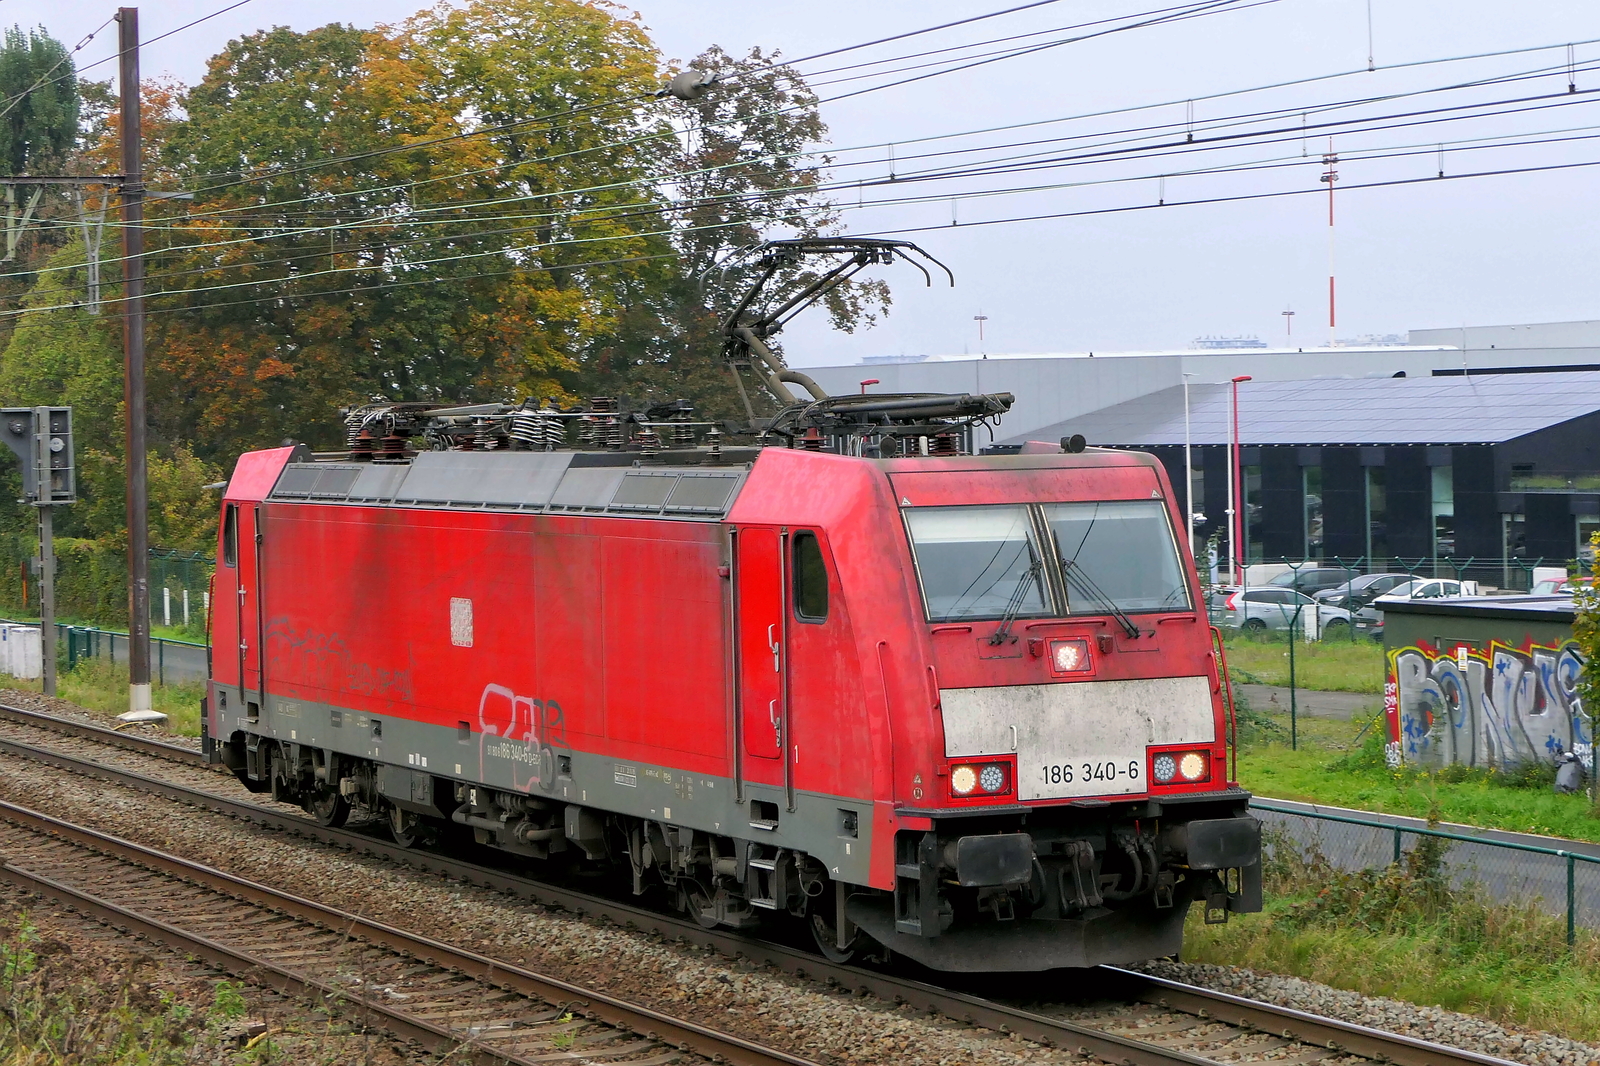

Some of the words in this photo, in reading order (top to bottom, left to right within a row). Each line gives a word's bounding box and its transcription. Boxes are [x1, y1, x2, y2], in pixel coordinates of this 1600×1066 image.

[511, 744, 528, 763] 340-6
[1043, 764, 1074, 784] 186
[1082, 761, 1139, 783] 340-6
